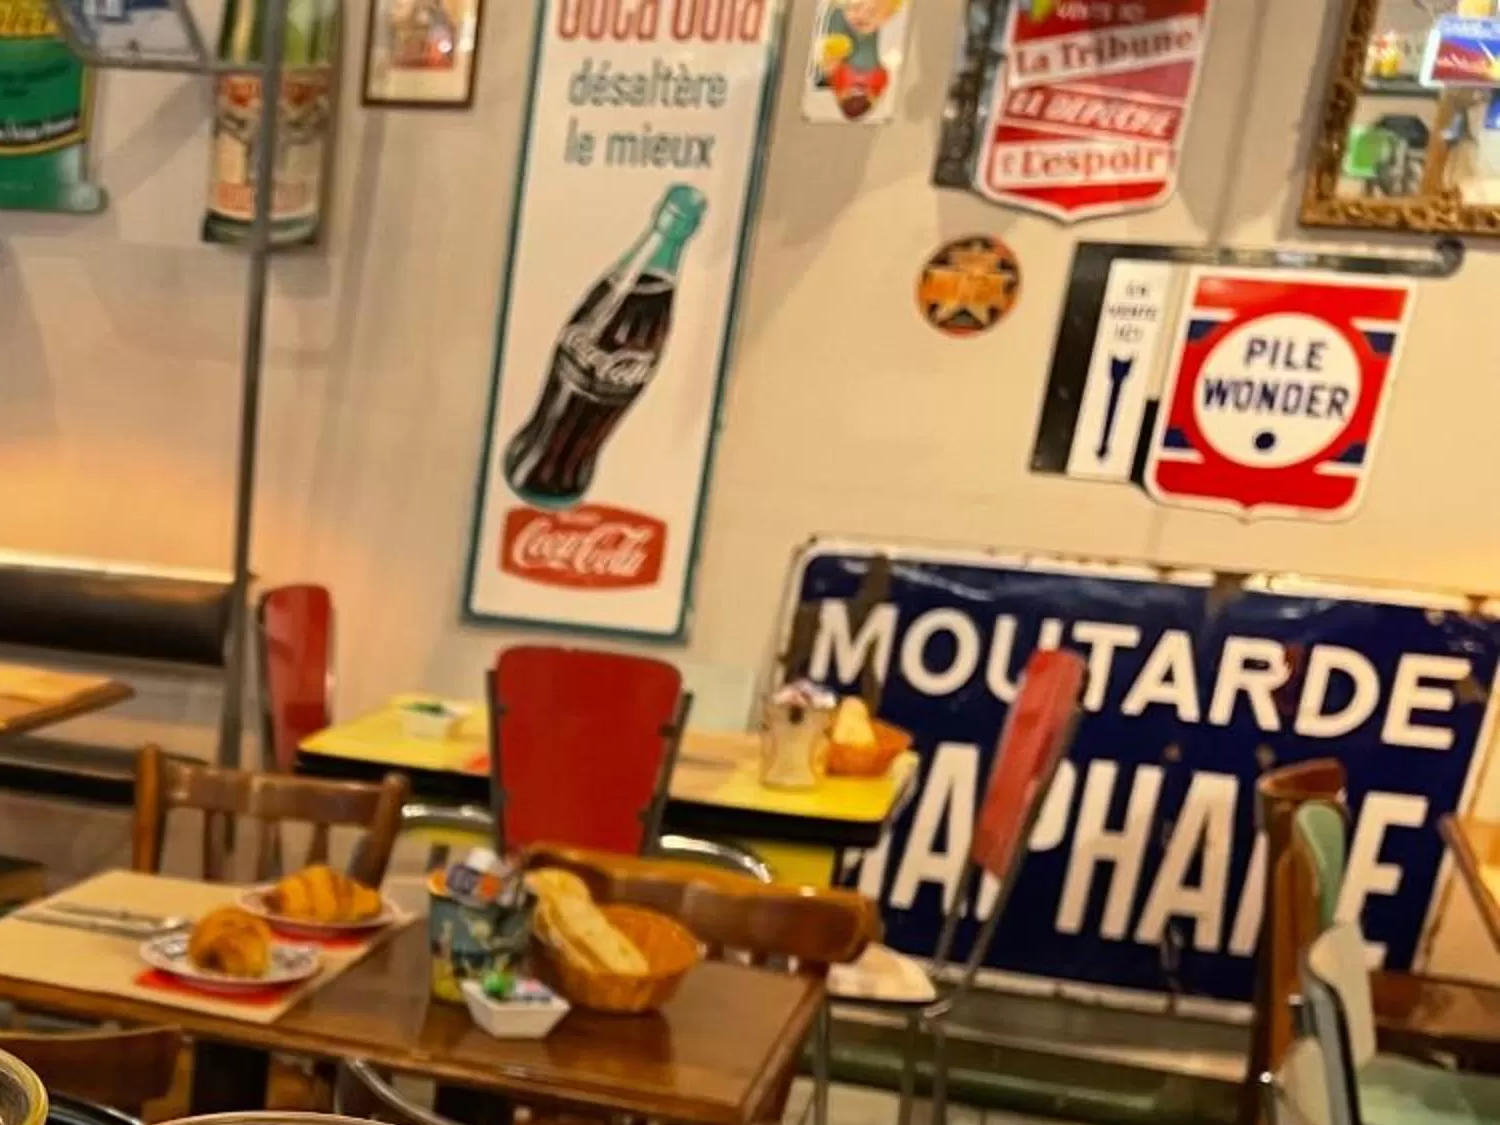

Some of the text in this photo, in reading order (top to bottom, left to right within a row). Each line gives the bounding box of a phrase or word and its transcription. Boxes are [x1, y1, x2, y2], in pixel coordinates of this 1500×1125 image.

[1061, 28, 1195, 69] Tribune
[568, 57, 729, 110] désaltère
[563, 116, 717, 169] le mieux
[1243, 335, 1328, 372] PILE
[1203, 376, 1351, 421] WONDER
[808, 598, 1473, 751] MOUTARDE
